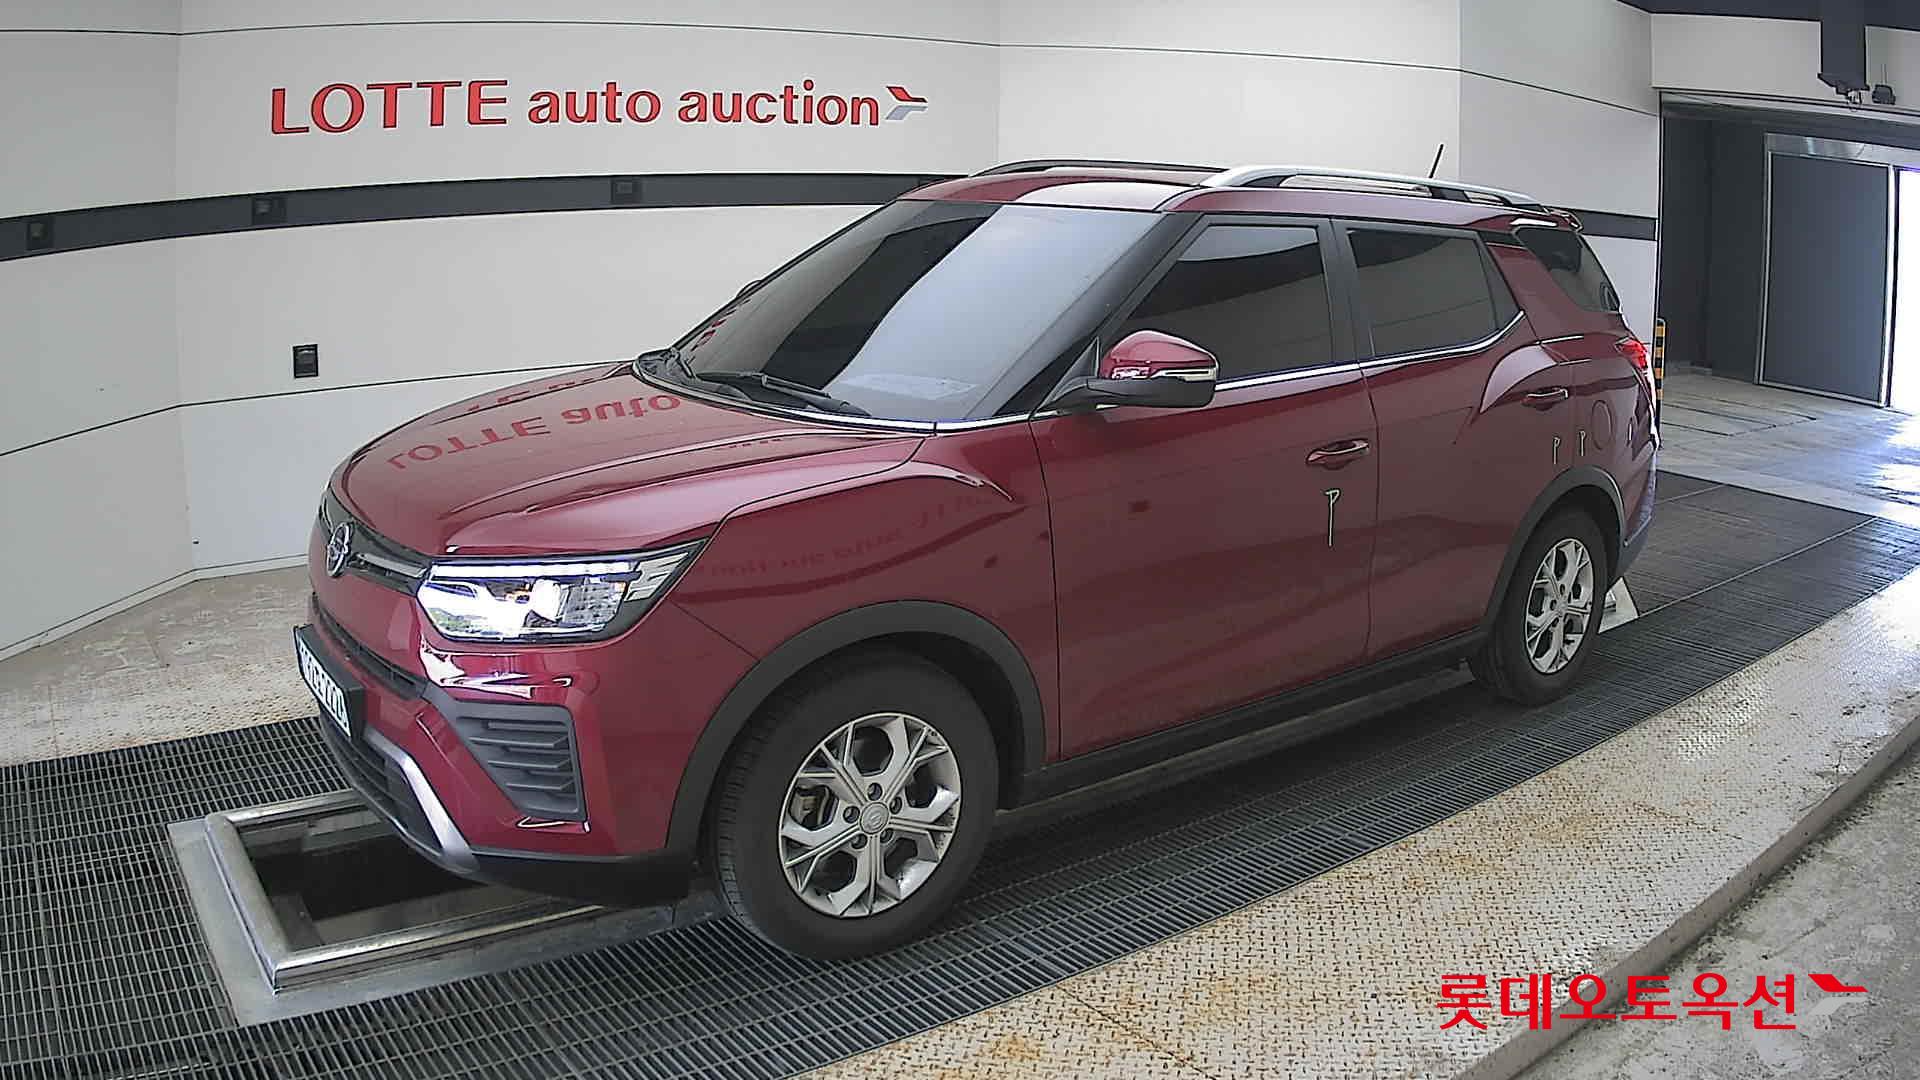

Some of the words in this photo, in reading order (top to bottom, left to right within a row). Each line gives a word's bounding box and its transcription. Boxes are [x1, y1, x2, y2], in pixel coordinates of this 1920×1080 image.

[271, 79, 508, 135] LOTTE
[528, 81, 662, 125] auto
[677, 79, 880, 127] auction
